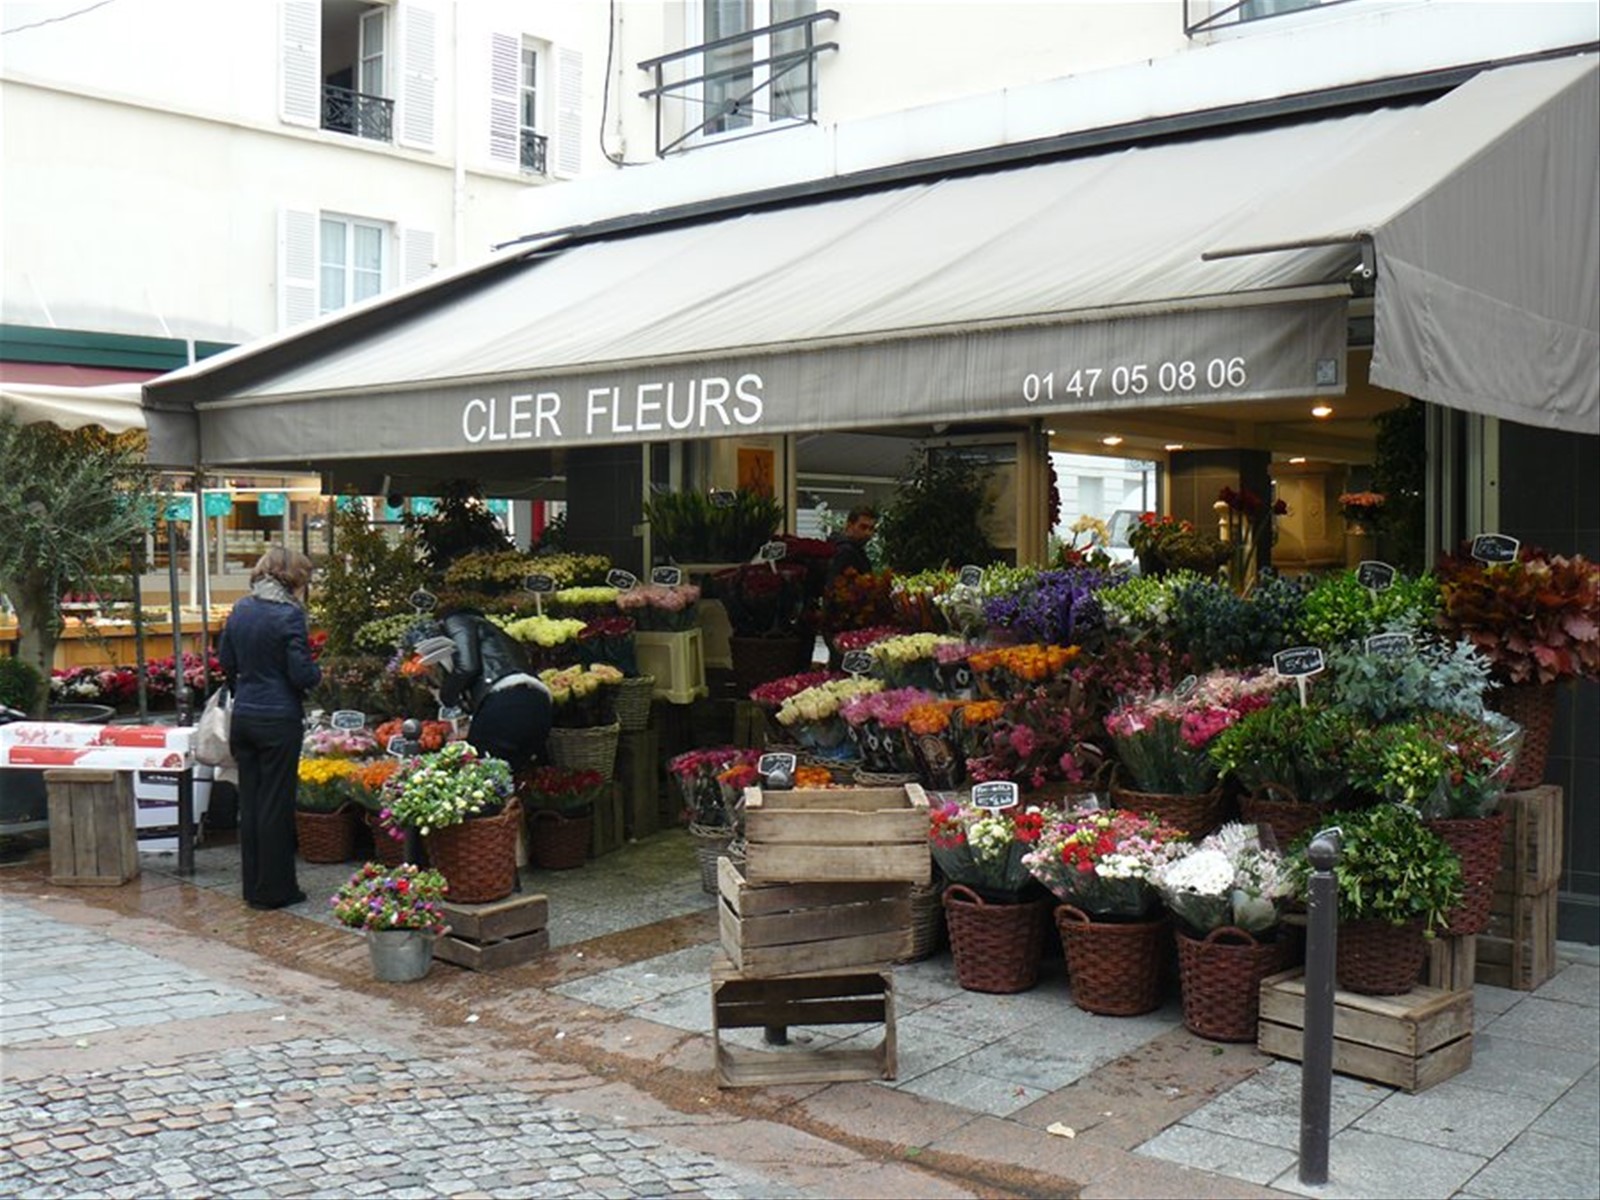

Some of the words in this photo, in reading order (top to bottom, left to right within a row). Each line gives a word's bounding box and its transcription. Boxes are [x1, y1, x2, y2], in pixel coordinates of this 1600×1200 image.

[1023, 373, 1054, 401] 01
[1066, 368, 1102, 397] 47
[1111, 364, 1148, 394] 05
[1158, 361, 1196, 391] 08
[1207, 357, 1246, 388] 06
[462, 392, 562, 442] CLER
[586, 374, 763, 434] FLEURS
